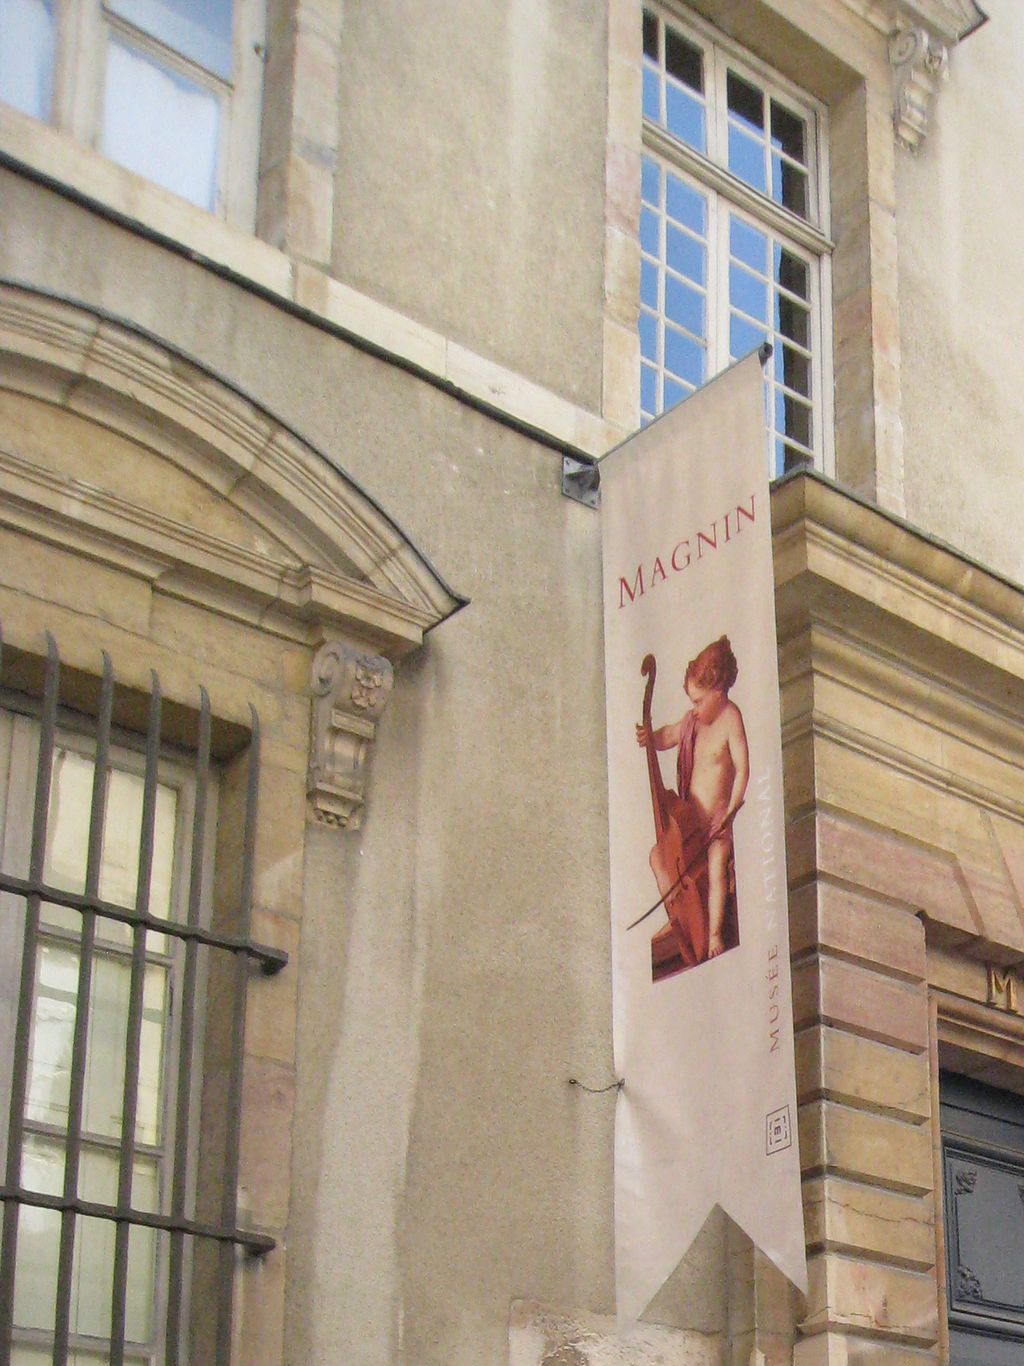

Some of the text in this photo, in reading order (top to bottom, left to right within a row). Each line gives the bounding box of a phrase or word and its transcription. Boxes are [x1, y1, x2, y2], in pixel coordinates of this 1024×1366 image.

[618, 495, 755, 609] MAGNIN
[757, 768, 780, 1052] MUSÉE NATIONAL
